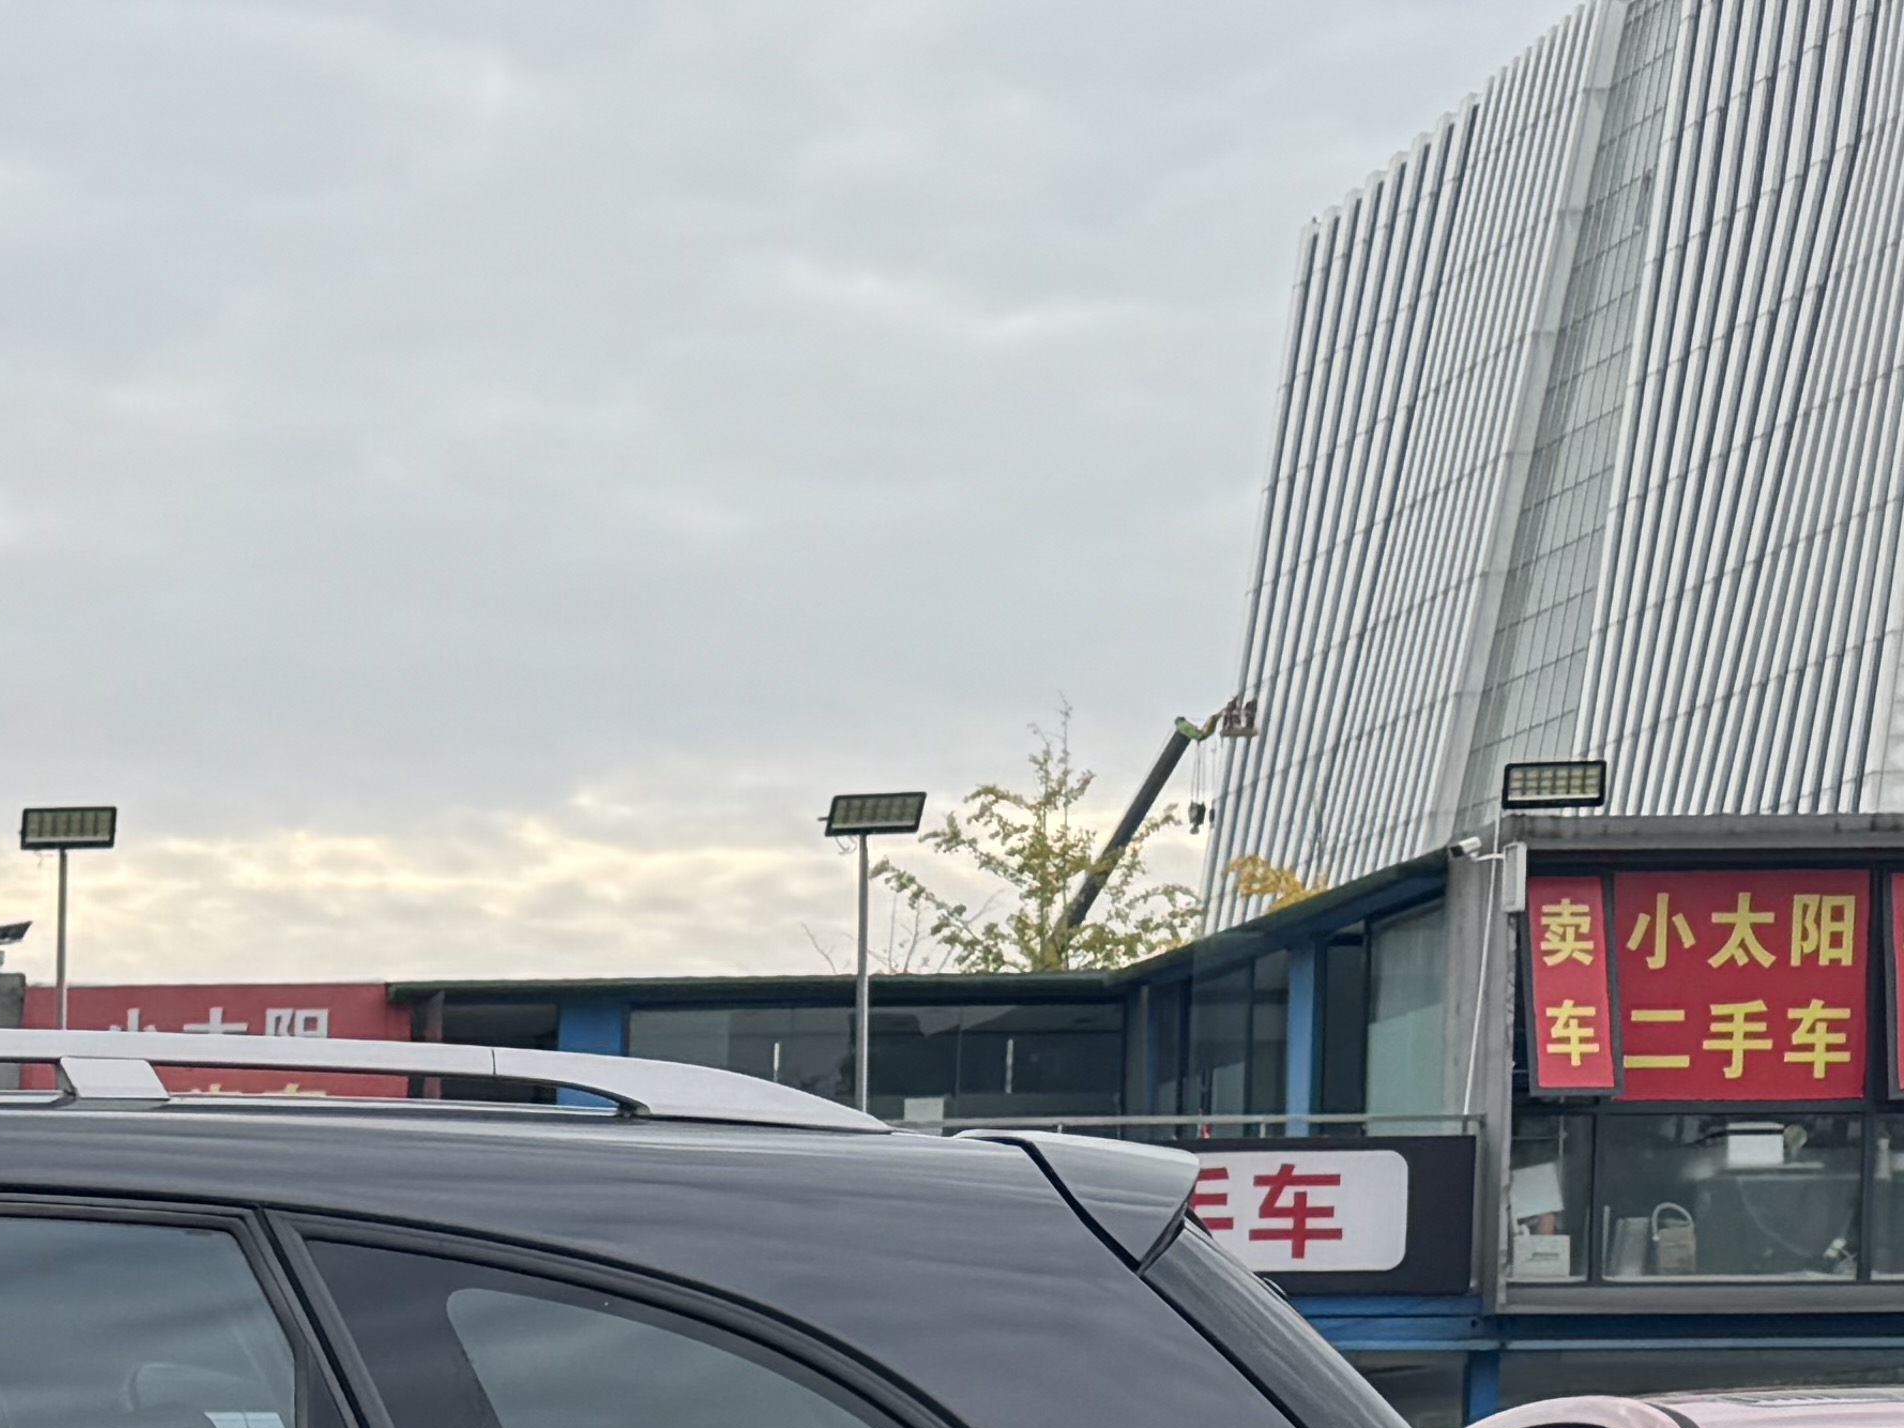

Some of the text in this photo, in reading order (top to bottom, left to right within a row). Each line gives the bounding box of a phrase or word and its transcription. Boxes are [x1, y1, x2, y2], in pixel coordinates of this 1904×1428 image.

[1626, 892, 1857, 970] 小太阳
[1622, 999, 1853, 1079] 二手车
